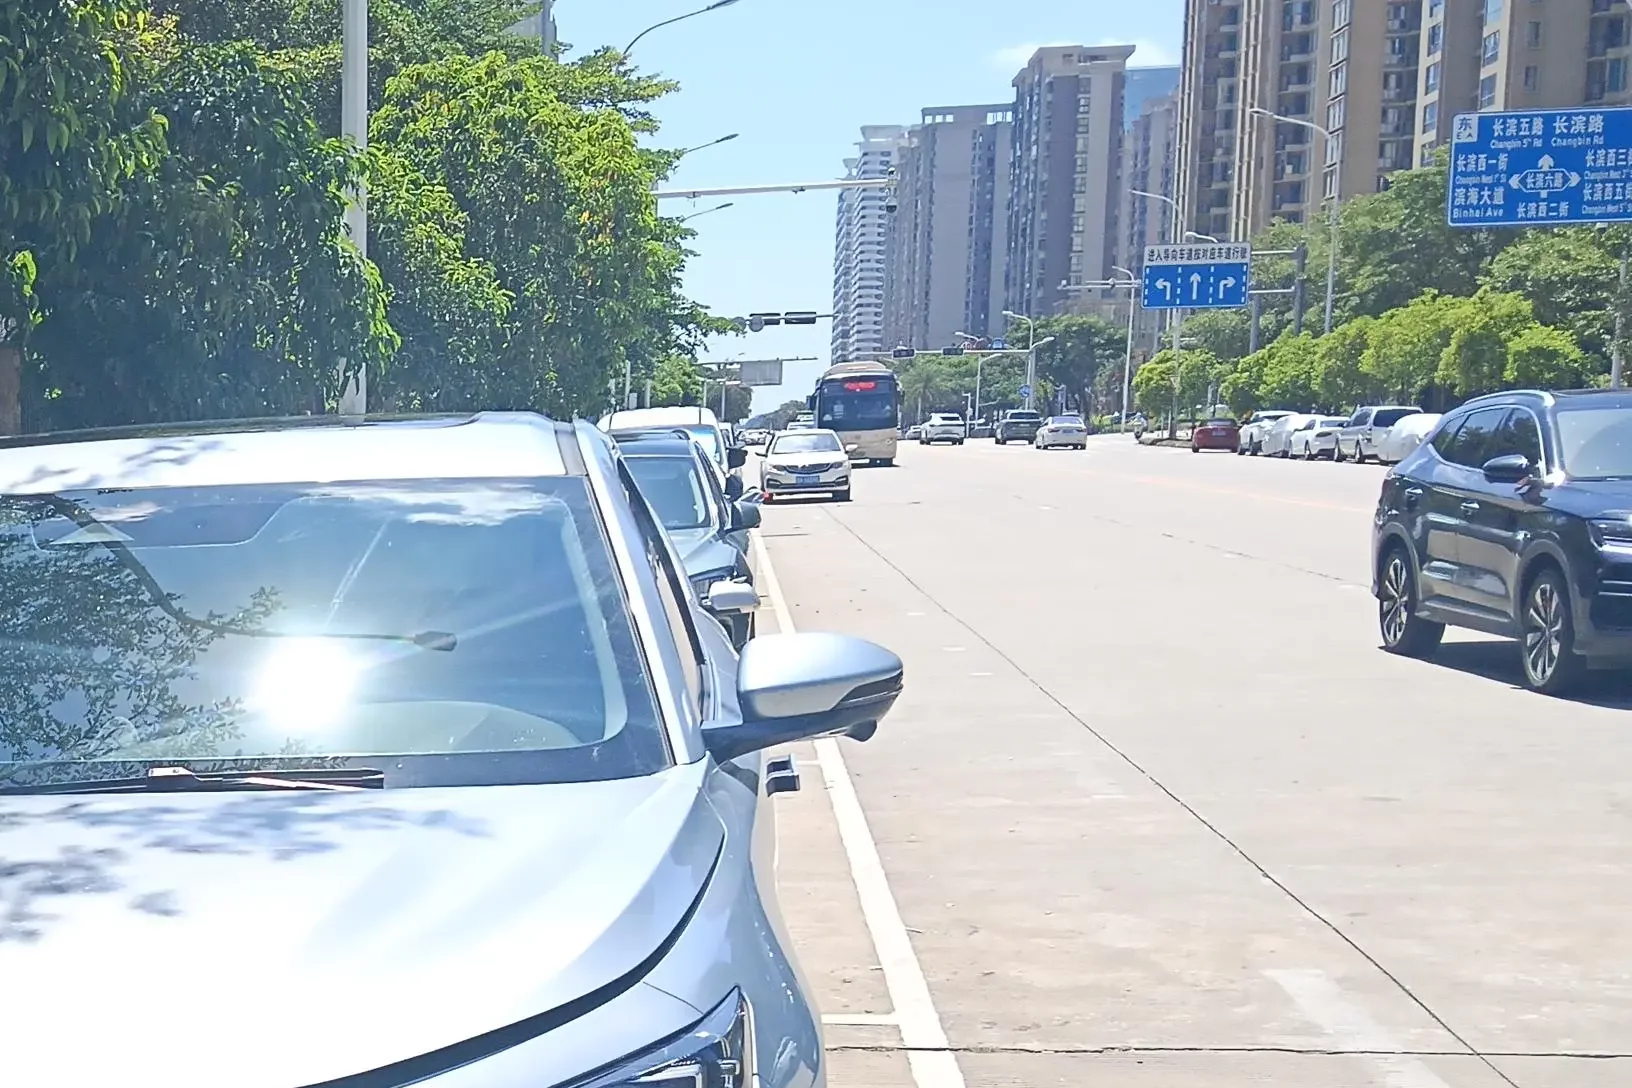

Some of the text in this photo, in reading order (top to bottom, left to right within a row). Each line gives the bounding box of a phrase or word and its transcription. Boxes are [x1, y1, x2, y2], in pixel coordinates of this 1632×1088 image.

[1493, 118, 1543, 136] 长滨五路
[1553, 114, 1604, 134] 长滨路
[1551, 135, 1604, 148] Changbin Rd
[1454, 186, 1505, 206] 滨海大道
[1485, 207, 1504, 217] Ave
[1517, 201, 1569, 218] 长滨西二街
[1148, 246, 1247, 262] 进入导向车道按对应车道行驶
